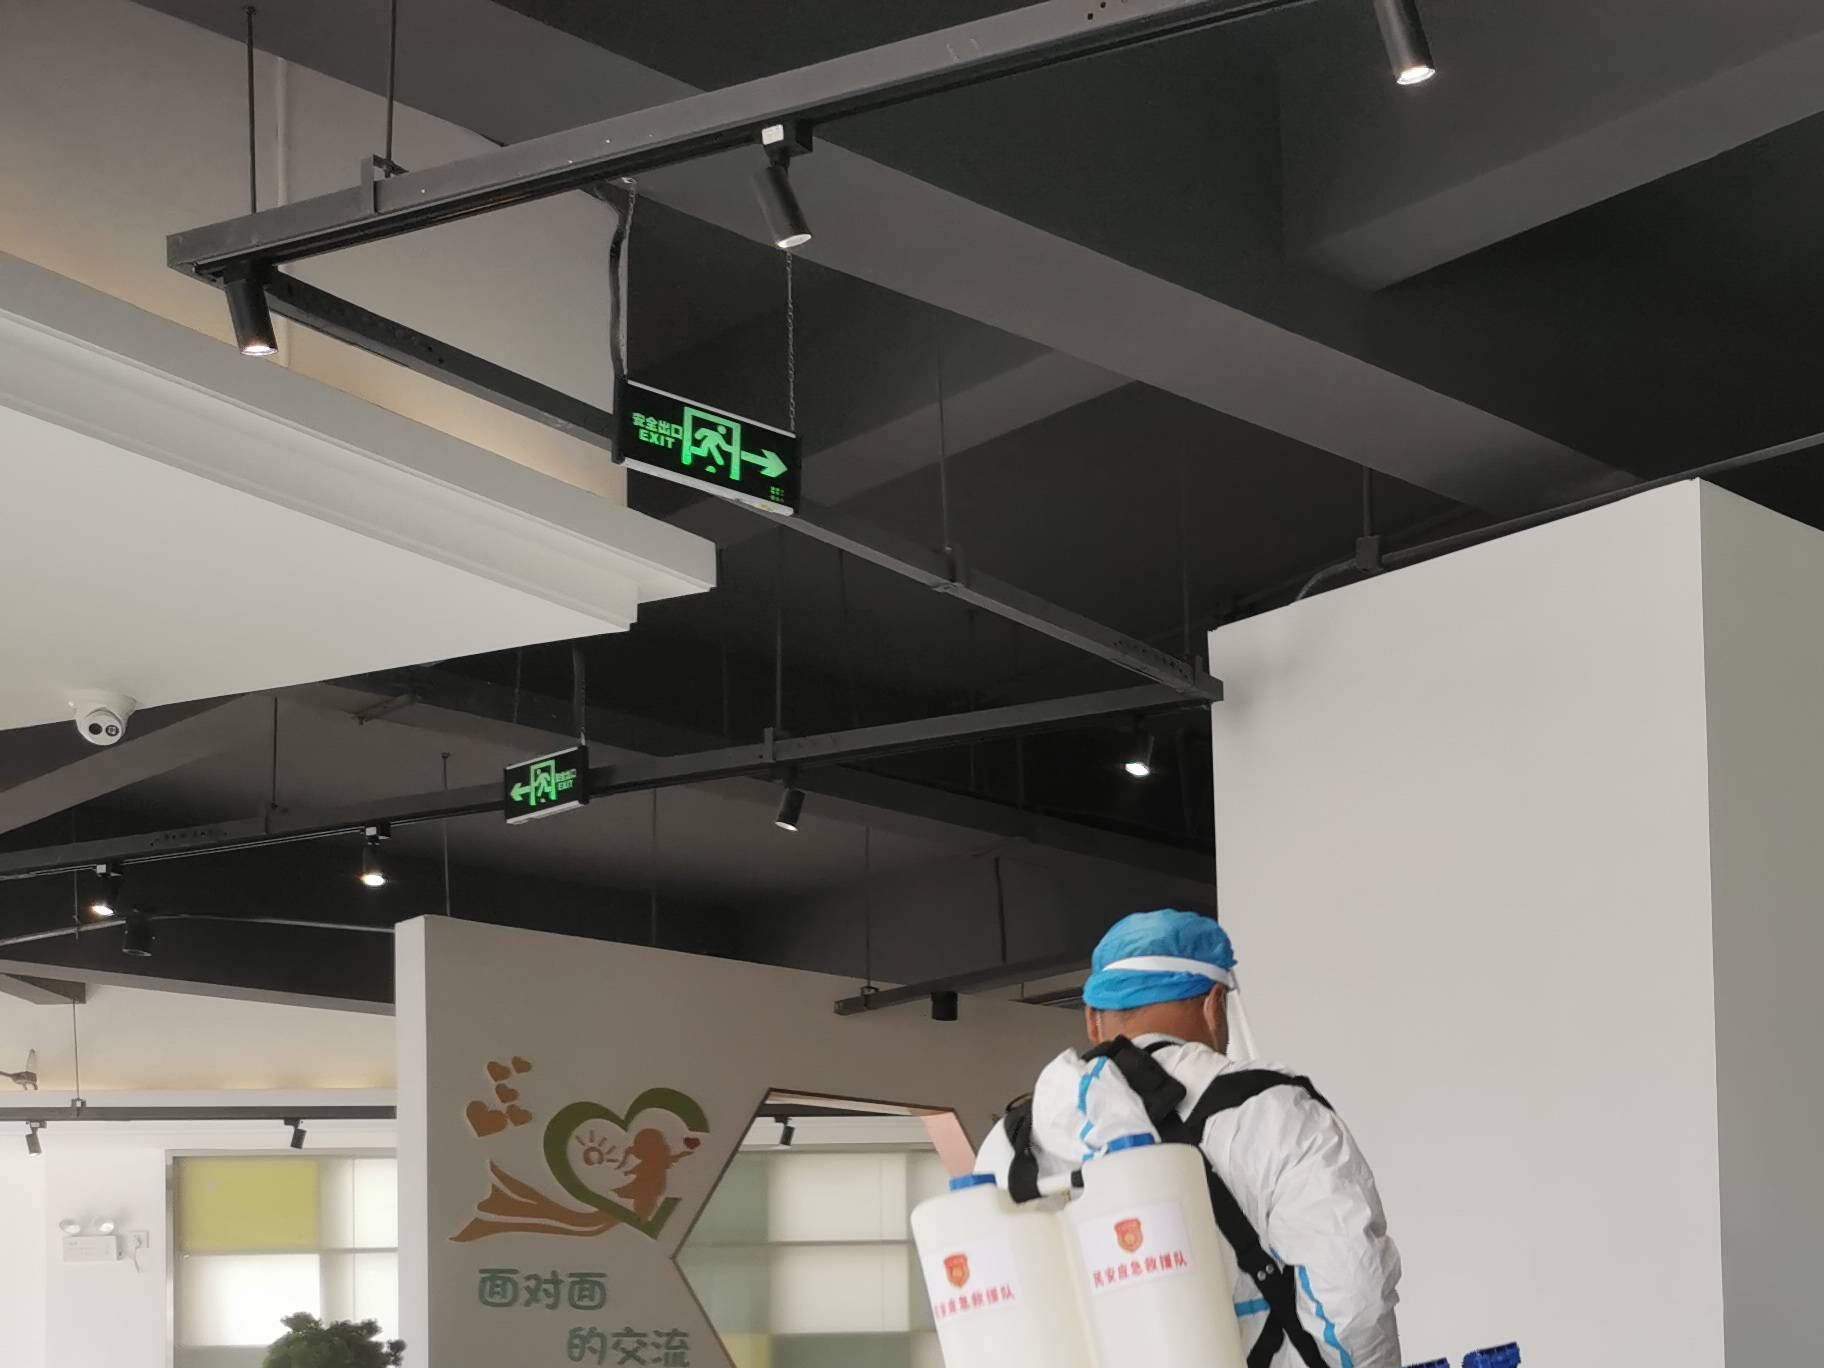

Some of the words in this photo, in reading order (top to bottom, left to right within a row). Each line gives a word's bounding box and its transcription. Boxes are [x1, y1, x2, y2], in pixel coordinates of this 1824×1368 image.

[632, 413, 683, 440] 安全出口
[639, 430, 676, 449] EXIT
[558, 780, 574, 791] EXIT
[478, 1268, 608, 1311] 面对面
[567, 1326, 691, 1368] 的交流
